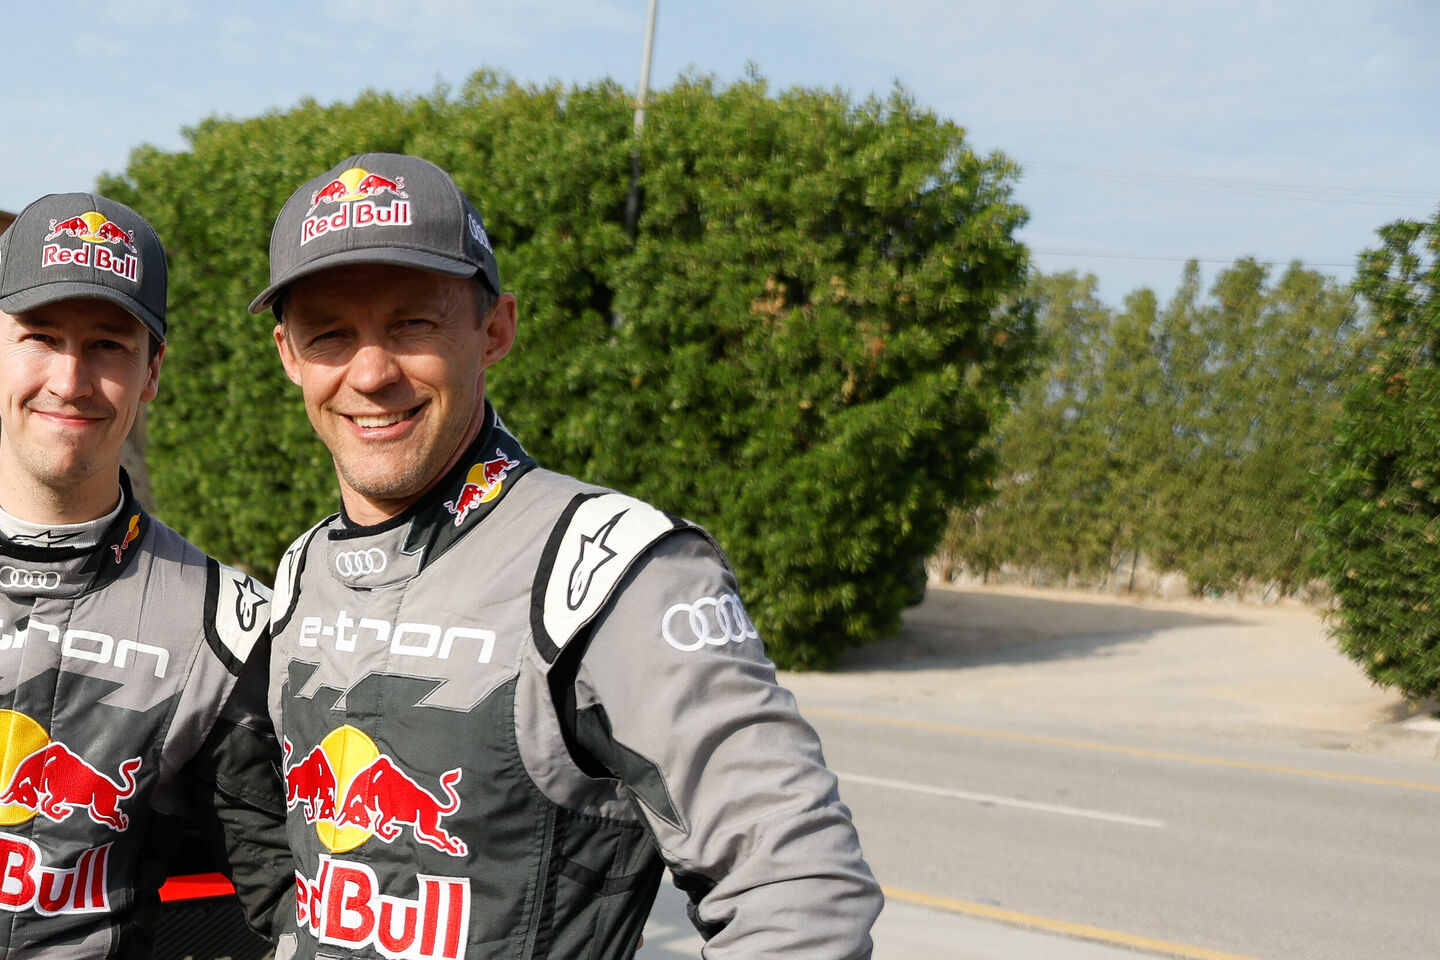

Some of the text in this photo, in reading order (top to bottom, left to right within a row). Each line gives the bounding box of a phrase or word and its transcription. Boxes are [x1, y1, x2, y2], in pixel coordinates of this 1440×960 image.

[300, 200, 412, 246] Red Bull
[42, 242, 138, 282] Red Bull
[298, 609, 497, 664] e-tron
[295, 853, 332, 938] ed
